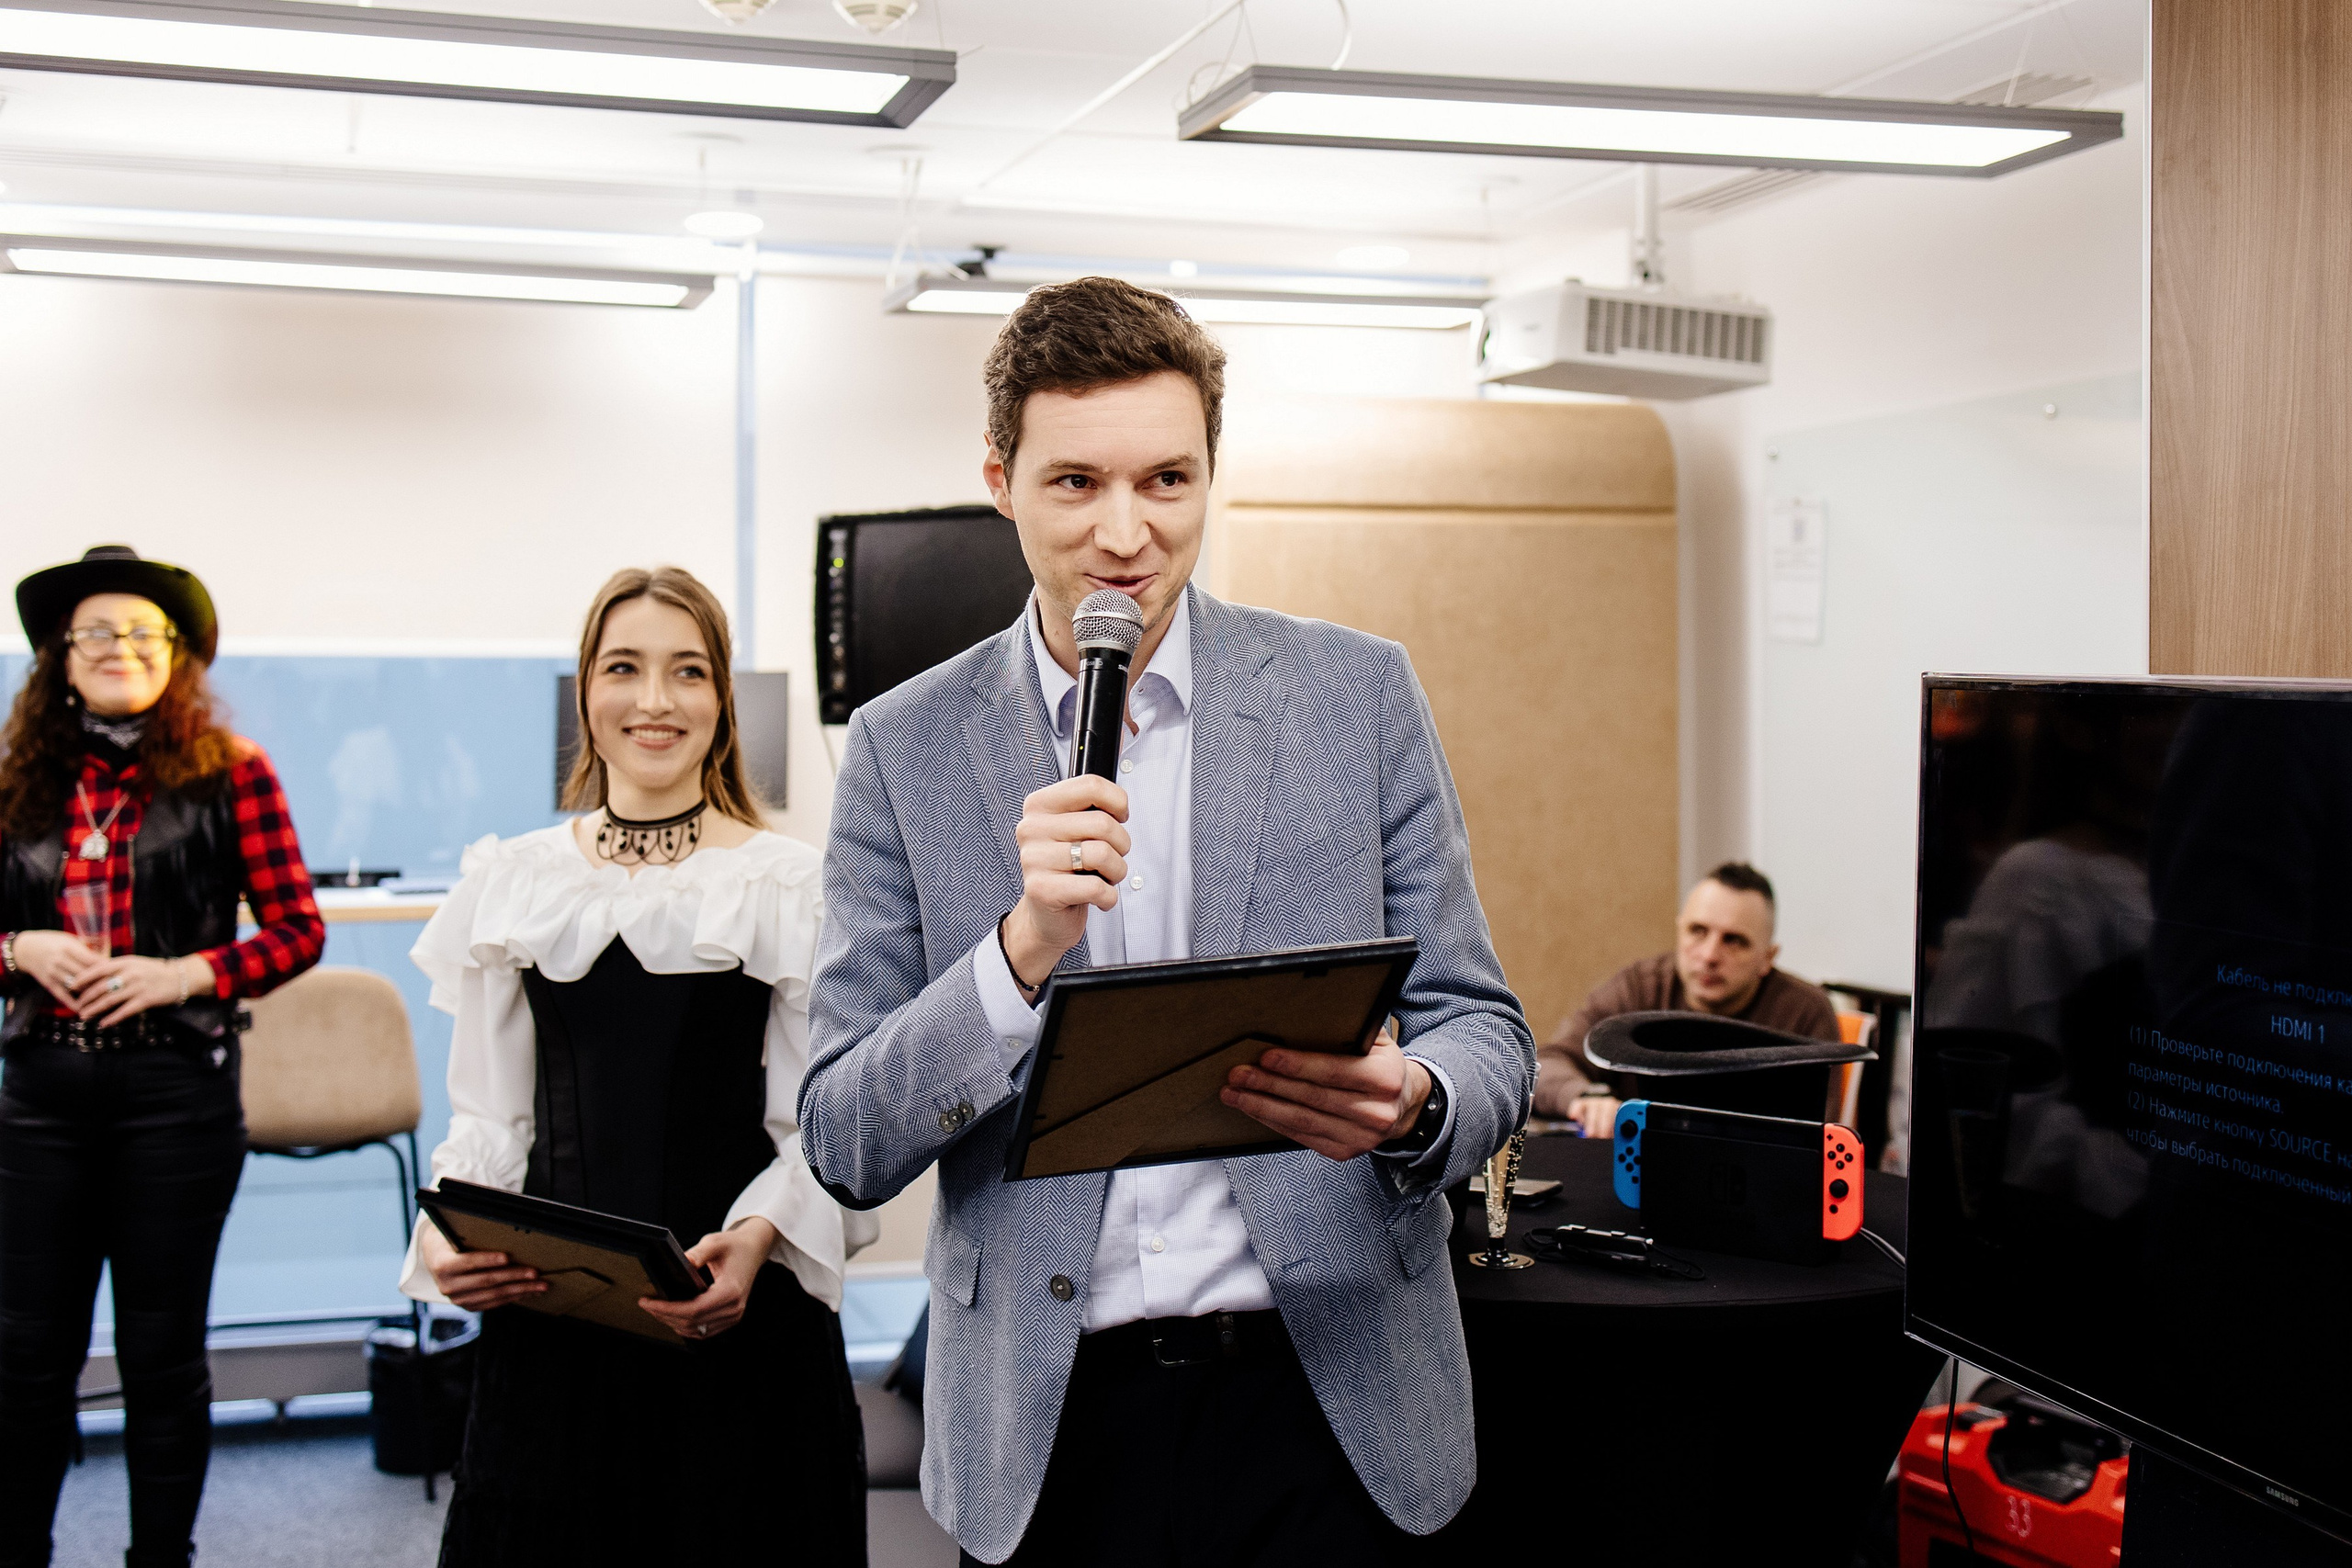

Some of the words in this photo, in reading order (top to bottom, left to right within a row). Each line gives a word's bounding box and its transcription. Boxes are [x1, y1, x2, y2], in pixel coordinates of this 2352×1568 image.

[2217, 964, 2269, 992] Кабель
[2274, 980, 2291, 996] не
[2270, 1014, 2312, 1041] HDMI
[2318, 1024, 2325, 1043] 1
[2130, 1024, 2147, 1046] (1)
[2151, 1030, 2223, 1064] Проверьте
[2227, 1054, 2332, 1089] подключения
[2128, 1062, 2201, 1094] параметры
[2206, 1081, 2285, 1114] источника.
[2127, 1090, 2145, 1111] (2)
[2150, 1096, 2210, 1129] Нажмите
[2214, 1118, 2265, 1149] кнопку
[2269, 1128, 2332, 1163] SOURCE
[2126, 1127, 2167, 1151] чтобы
[2171, 1140, 2229, 1169] выбрать
[2233, 1157, 2352, 1205] подключенный
[2266, 1485, 2299, 1507] SAMSUNG
